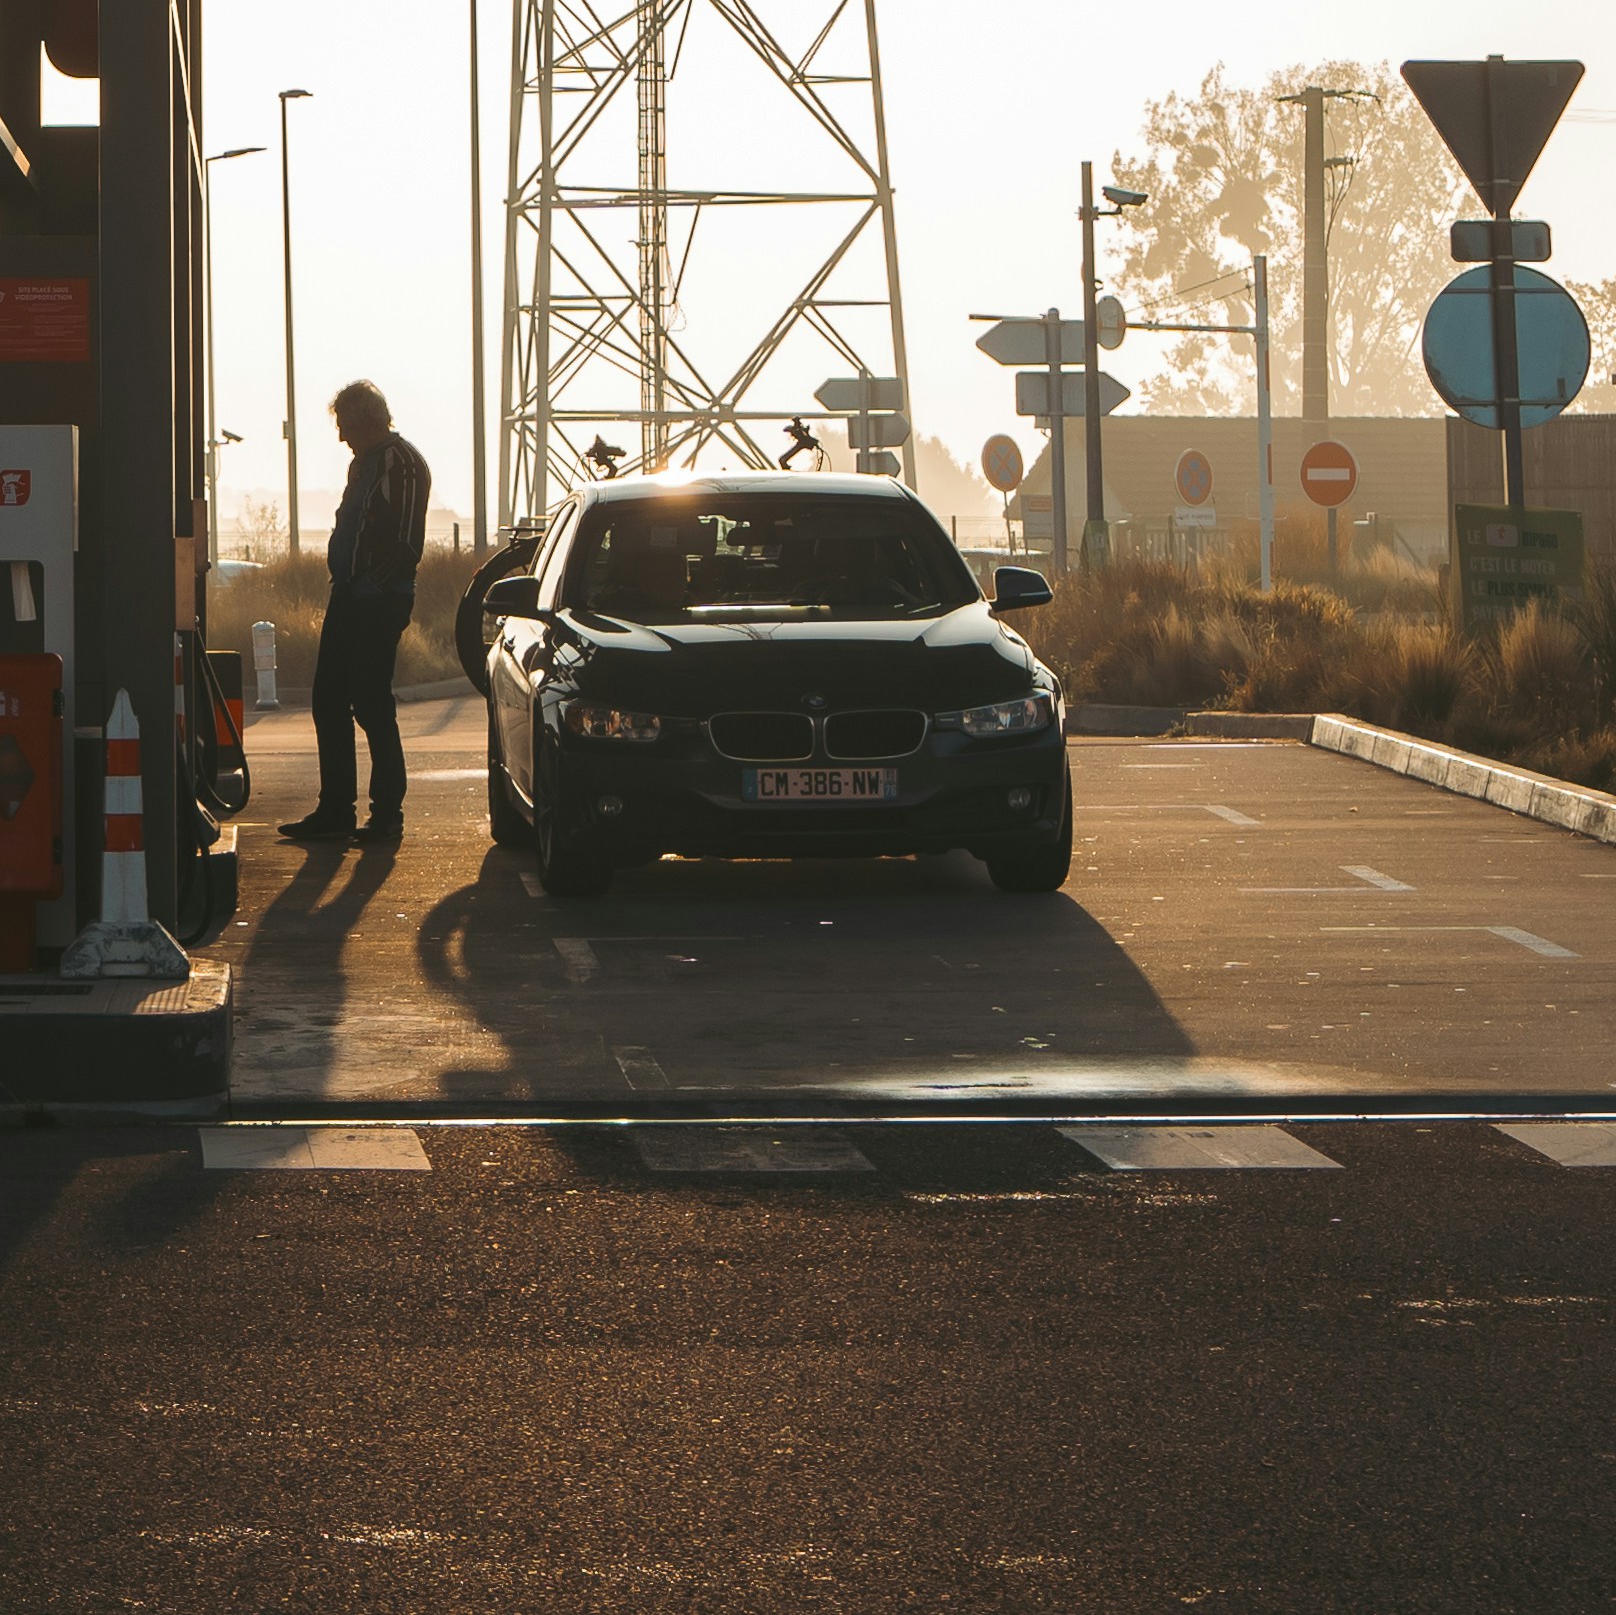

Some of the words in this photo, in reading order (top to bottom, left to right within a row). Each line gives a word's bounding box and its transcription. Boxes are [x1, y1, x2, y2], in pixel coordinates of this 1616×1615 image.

[1467, 529, 1482, 545] LE
[1470, 556, 1500, 573] C'EST
[1504, 557, 1517, 573] LE
[1519, 558, 1556, 575] MOYEN
[1472, 580, 1485, 596] LE
[1487, 581, 1514, 597] PLUS
[885, 784, 896, 796] 76
